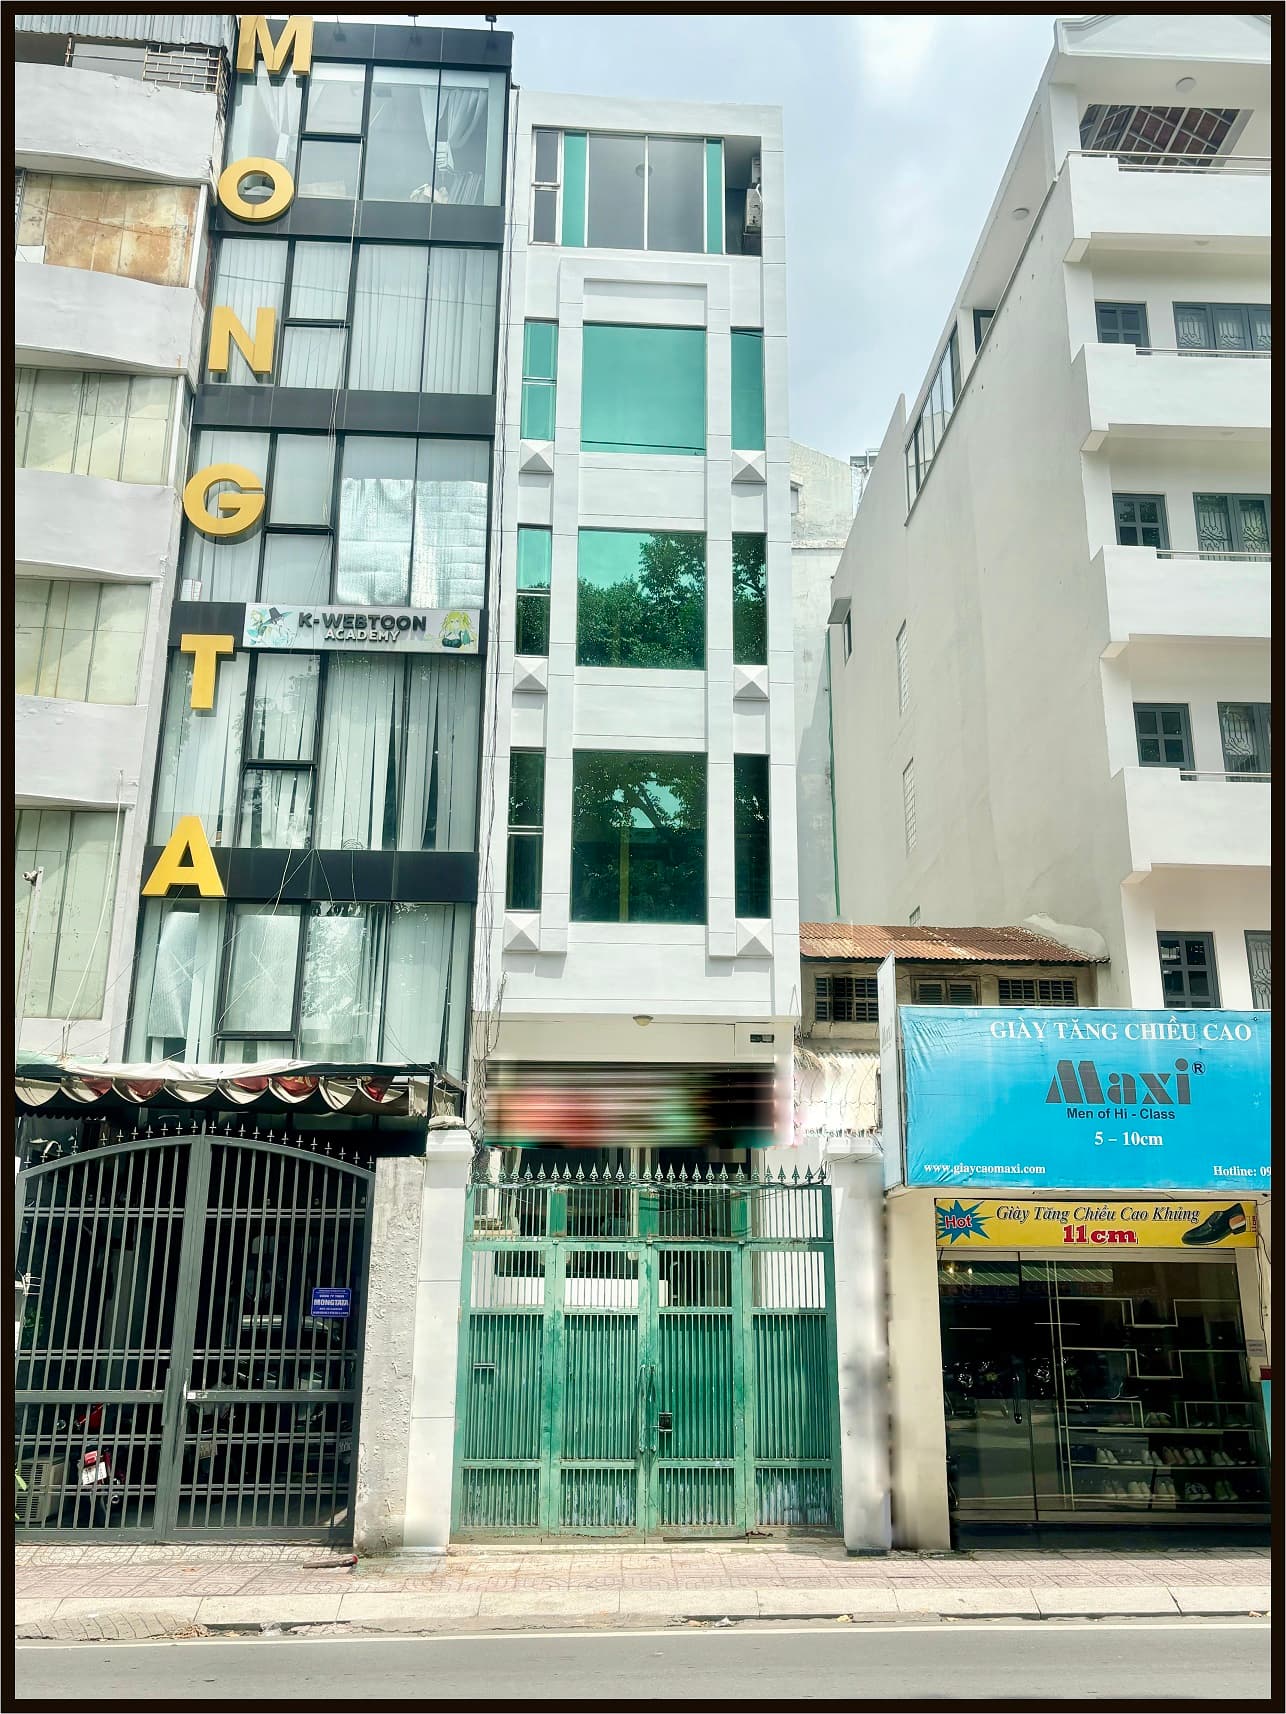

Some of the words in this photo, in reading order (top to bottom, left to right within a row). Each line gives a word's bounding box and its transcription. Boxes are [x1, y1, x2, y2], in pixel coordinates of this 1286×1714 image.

[299, 611, 427, 631] K-WEBTOON
[324, 629, 401, 642] ACADEMY
[989, 1016, 1048, 1040] GIÀY
[1053, 1018, 1118, 1041] TĂNG
[1124, 1015, 1197, 1041] CHIỀU
[1202, 1022, 1252, 1041] CAO
[1066, 1107, 1094, 1119] Men
[1097, 1107, 1111, 1119] of
[1114, 1108, 1128, 1119] Hi
[1139, 1108, 1176, 1120] Class
[1094, 1131, 1104, 1146] 5
[1122, 1131, 1163, 1147] 10cm
[923, 1162, 1046, 1176] www.giaycaomaxi.com
[1213, 1165, 1257, 1177] Hotline:
[945, 1215, 973, 1229] Hot
[1033, 1206, 1070, 1224] Tăng
[1120, 1206, 1149, 1222] Cao
[1062, 1224, 1138, 1244] 11cm
